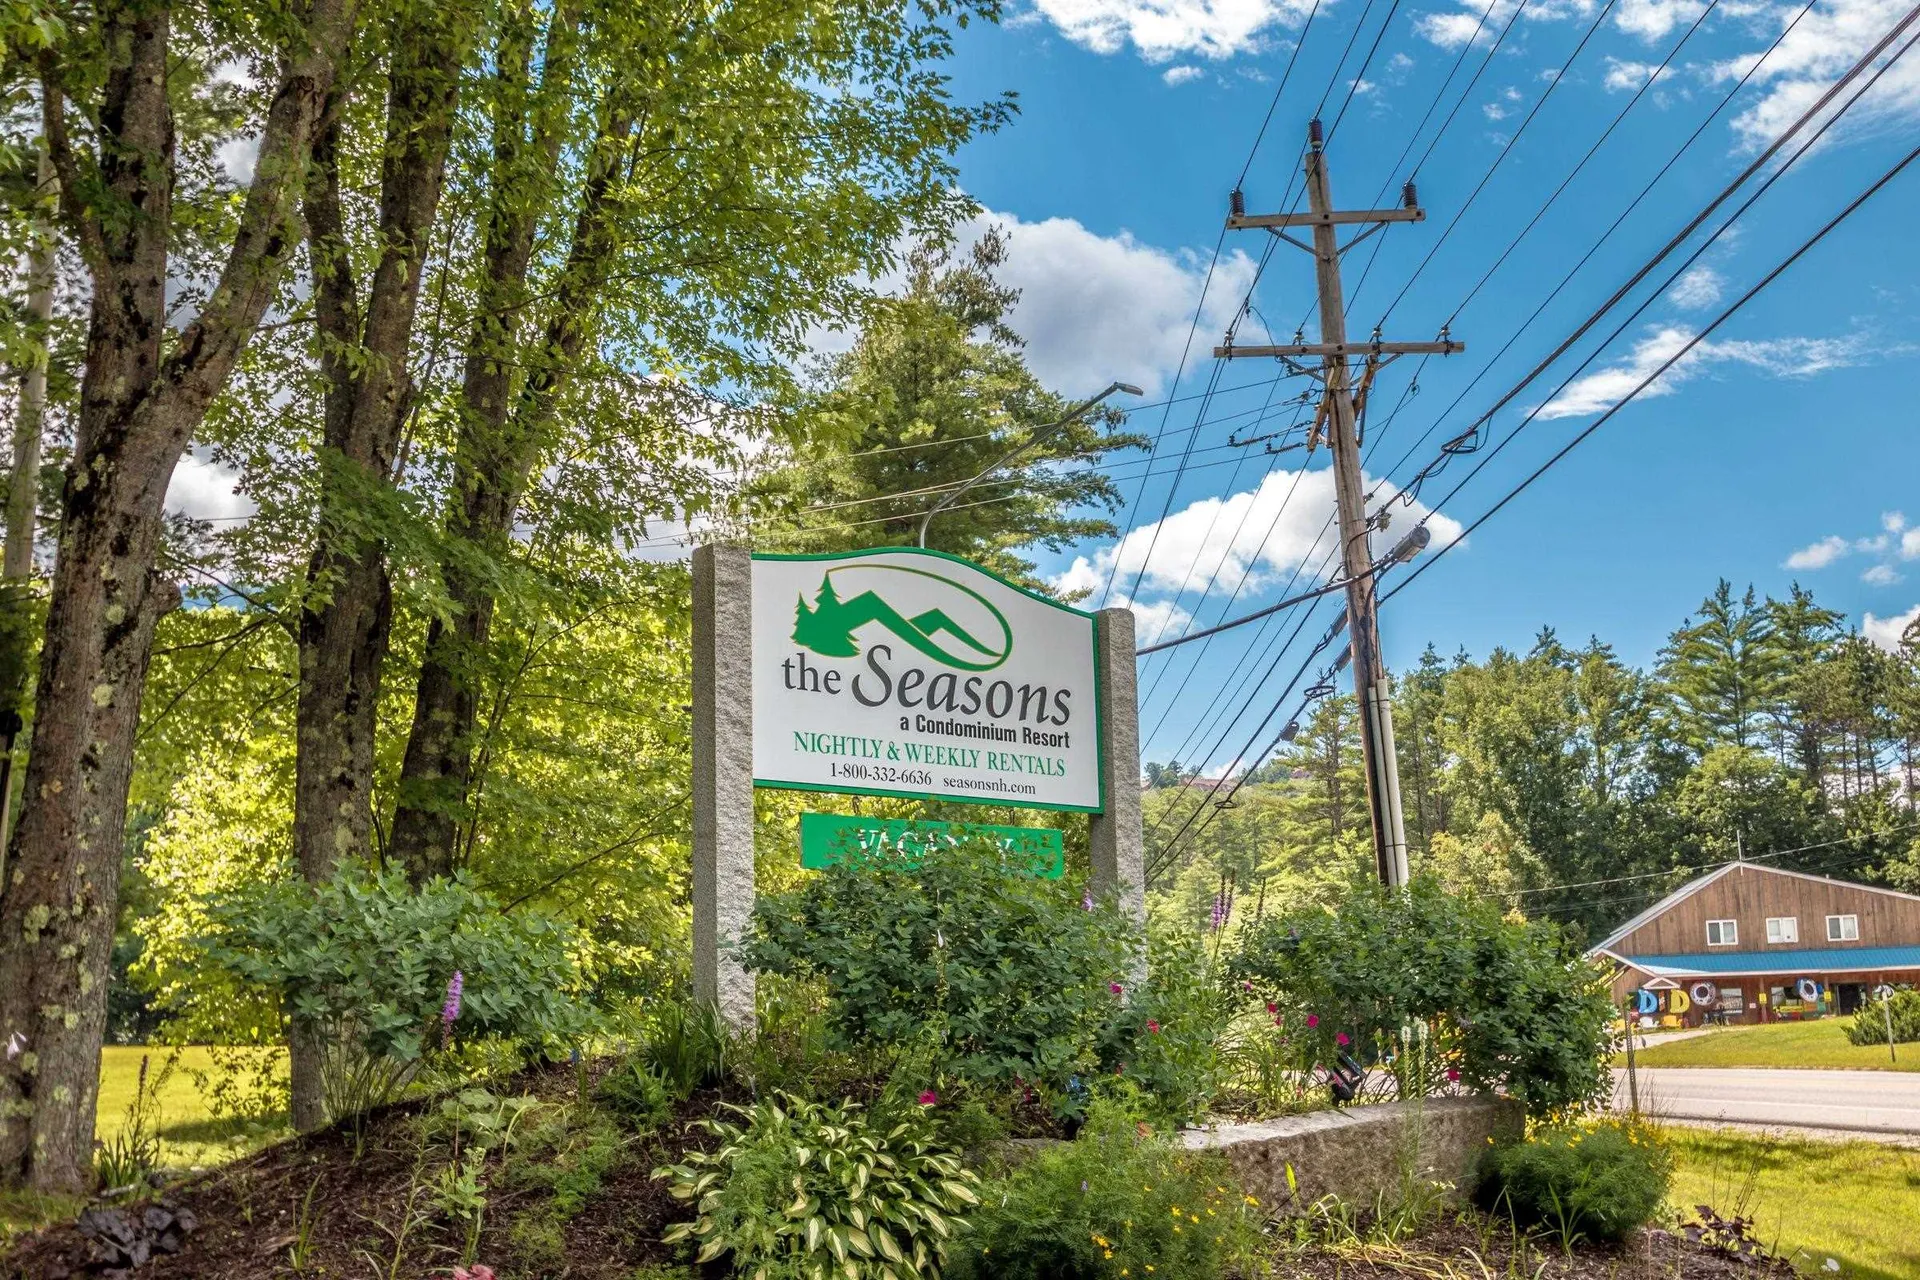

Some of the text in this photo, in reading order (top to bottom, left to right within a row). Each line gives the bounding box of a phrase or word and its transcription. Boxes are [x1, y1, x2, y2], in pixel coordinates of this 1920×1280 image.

[781, 644, 1072, 727] the Seasons
[900, 714, 1071, 749] a Condominium Resort
[793, 730, 1066, 777] NIGHTLY & WEEKLY RENTALS
[830, 762, 1036, 795] 1-800-332-6636 seasonsnh.com
